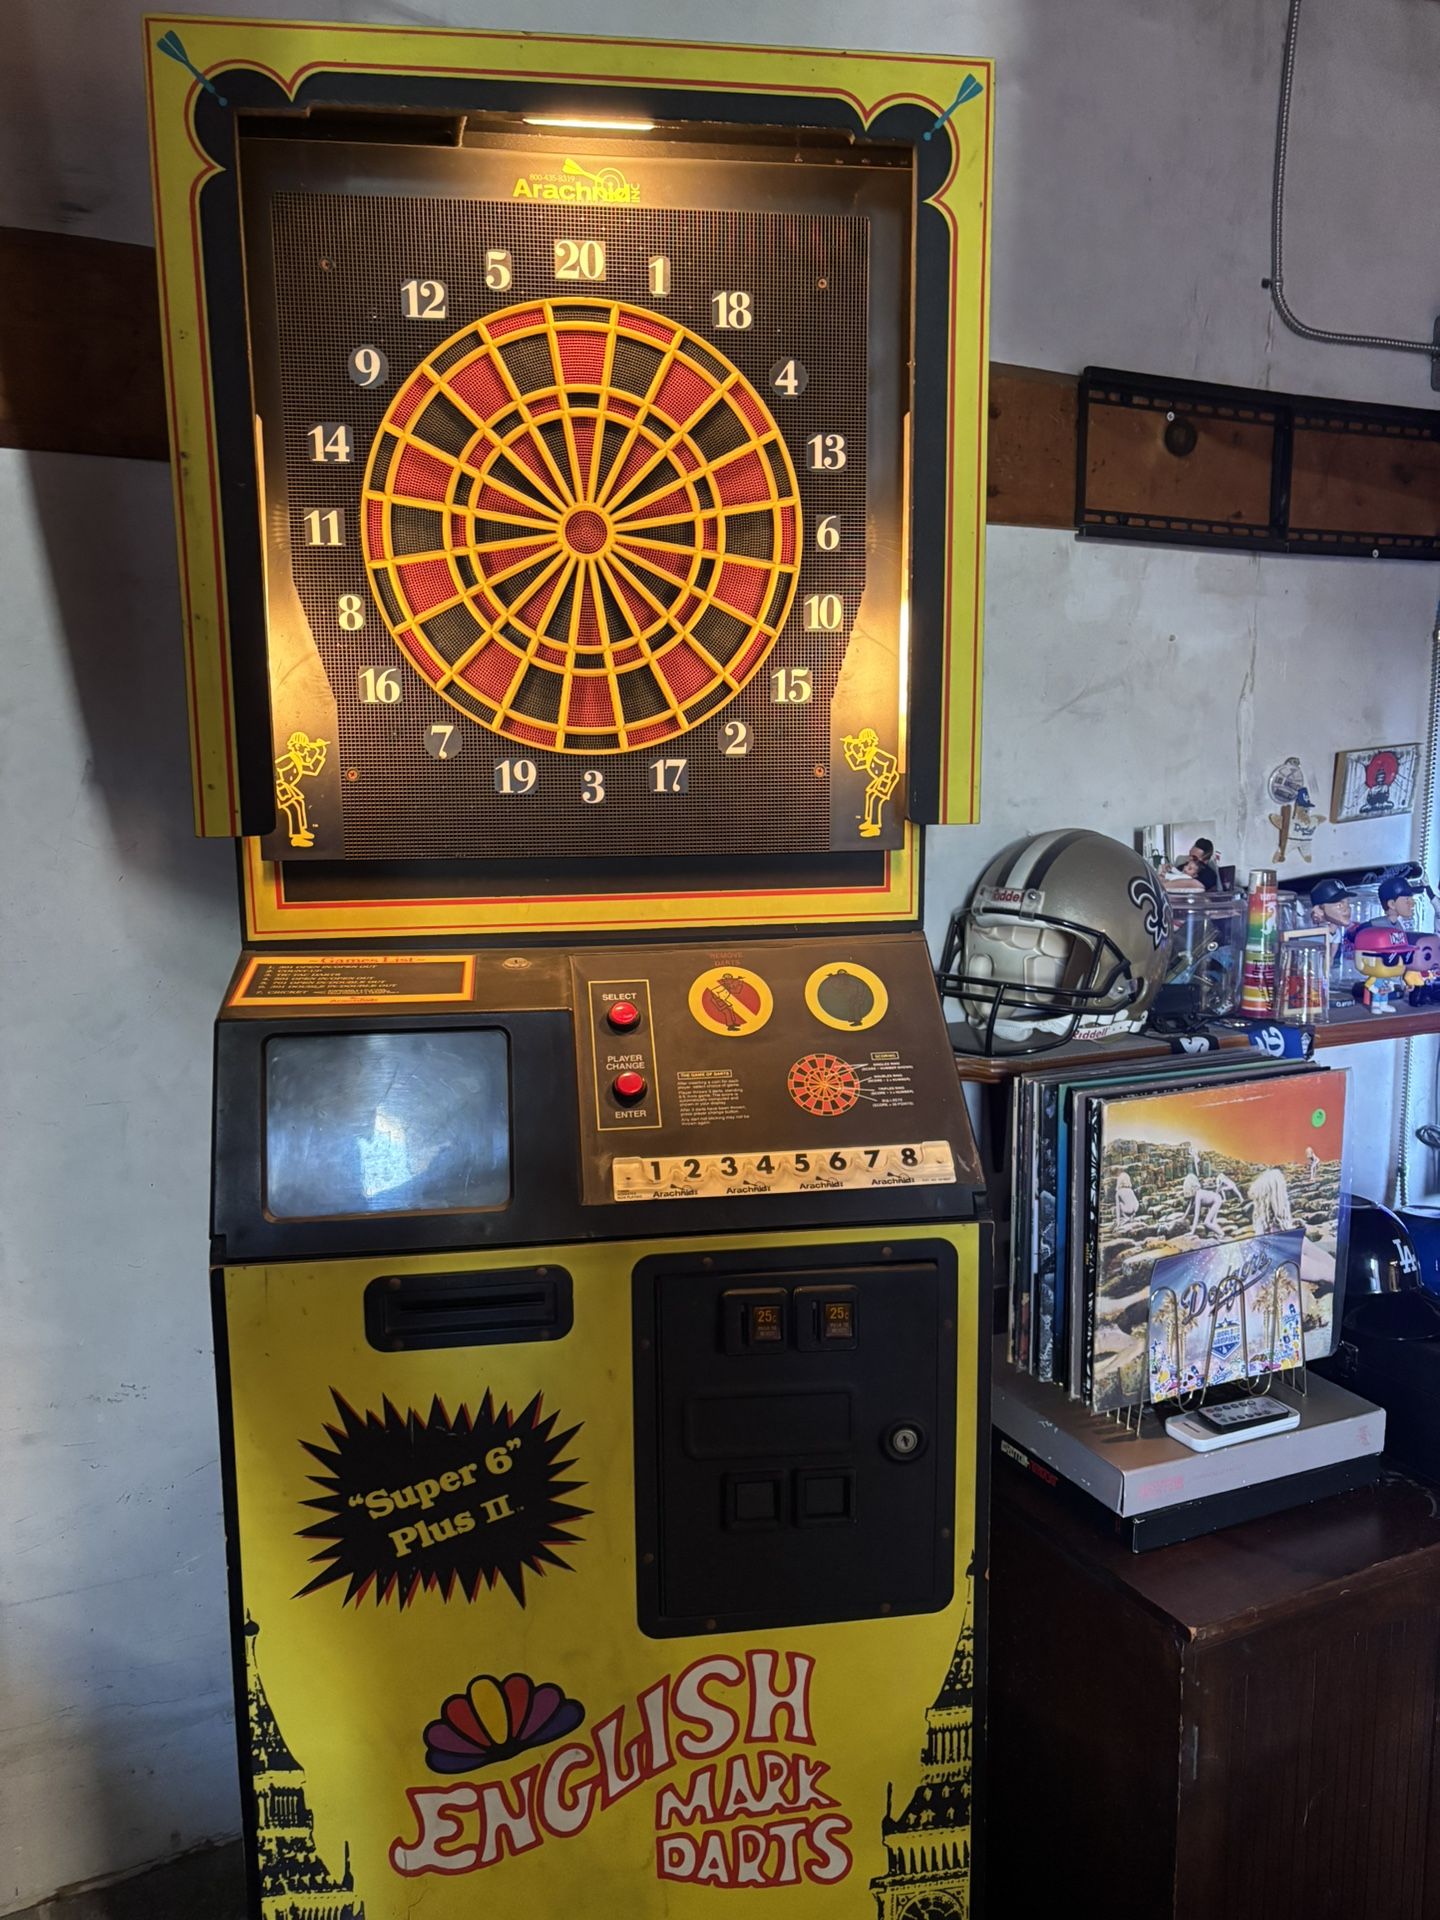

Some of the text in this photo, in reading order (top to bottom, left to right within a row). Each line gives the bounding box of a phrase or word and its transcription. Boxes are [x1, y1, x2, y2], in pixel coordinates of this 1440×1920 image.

[512, 178, 630, 203] Arachnid
[487, 250, 511, 287] 5
[555, 241, 603, 278] 20
[649, 257, 668, 294] 1
[401, 281, 445, 318] 12
[712, 292, 751, 328] 18
[355, 349, 380, 386] 9
[775, 360, 798, 395] 4
[308, 426, 350, 462] 14
[808, 435, 846, 469] 13
[304, 510, 342, 545] 11
[817, 516, 839, 550] 6
[339, 595, 363, 631] 8
[806, 595, 842, 630] 10
[359, 668, 399, 702] 16
[772, 668, 811, 702] 15
[431, 725, 454, 759] 7
[725, 721, 747, 754] 2
[495, 760, 536, 793] 19
[583, 771, 604, 803] 3
[650, 759, 687, 791] 17
[602, 992, 637, 1001] SELECT
[606, 1062, 645, 1071] CHANGE
[607, 1054, 643, 1063] PLAYER
[615, 1110, 647, 1119] ENTER
[651, 1148, 919, 1181] 1 2 3 4 5 6 7 8
[871, 1176, 911, 1186] Arachnid
[653, 1186, 695, 1198] Arachnid
[726, 1185, 768, 1195] Arachnid
[800, 1180, 840, 1190] Arachnid
[1392, 1238, 1417, 1274] LA
[1181, 1252, 1272, 1325] Dodgers
[388, 1494, 517, 1558] Plus II
[389, 1649, 816, 1877] ENGLISH
[655, 1750, 842, 1830] MARK
[656, 1813, 853, 1889] DARTS
